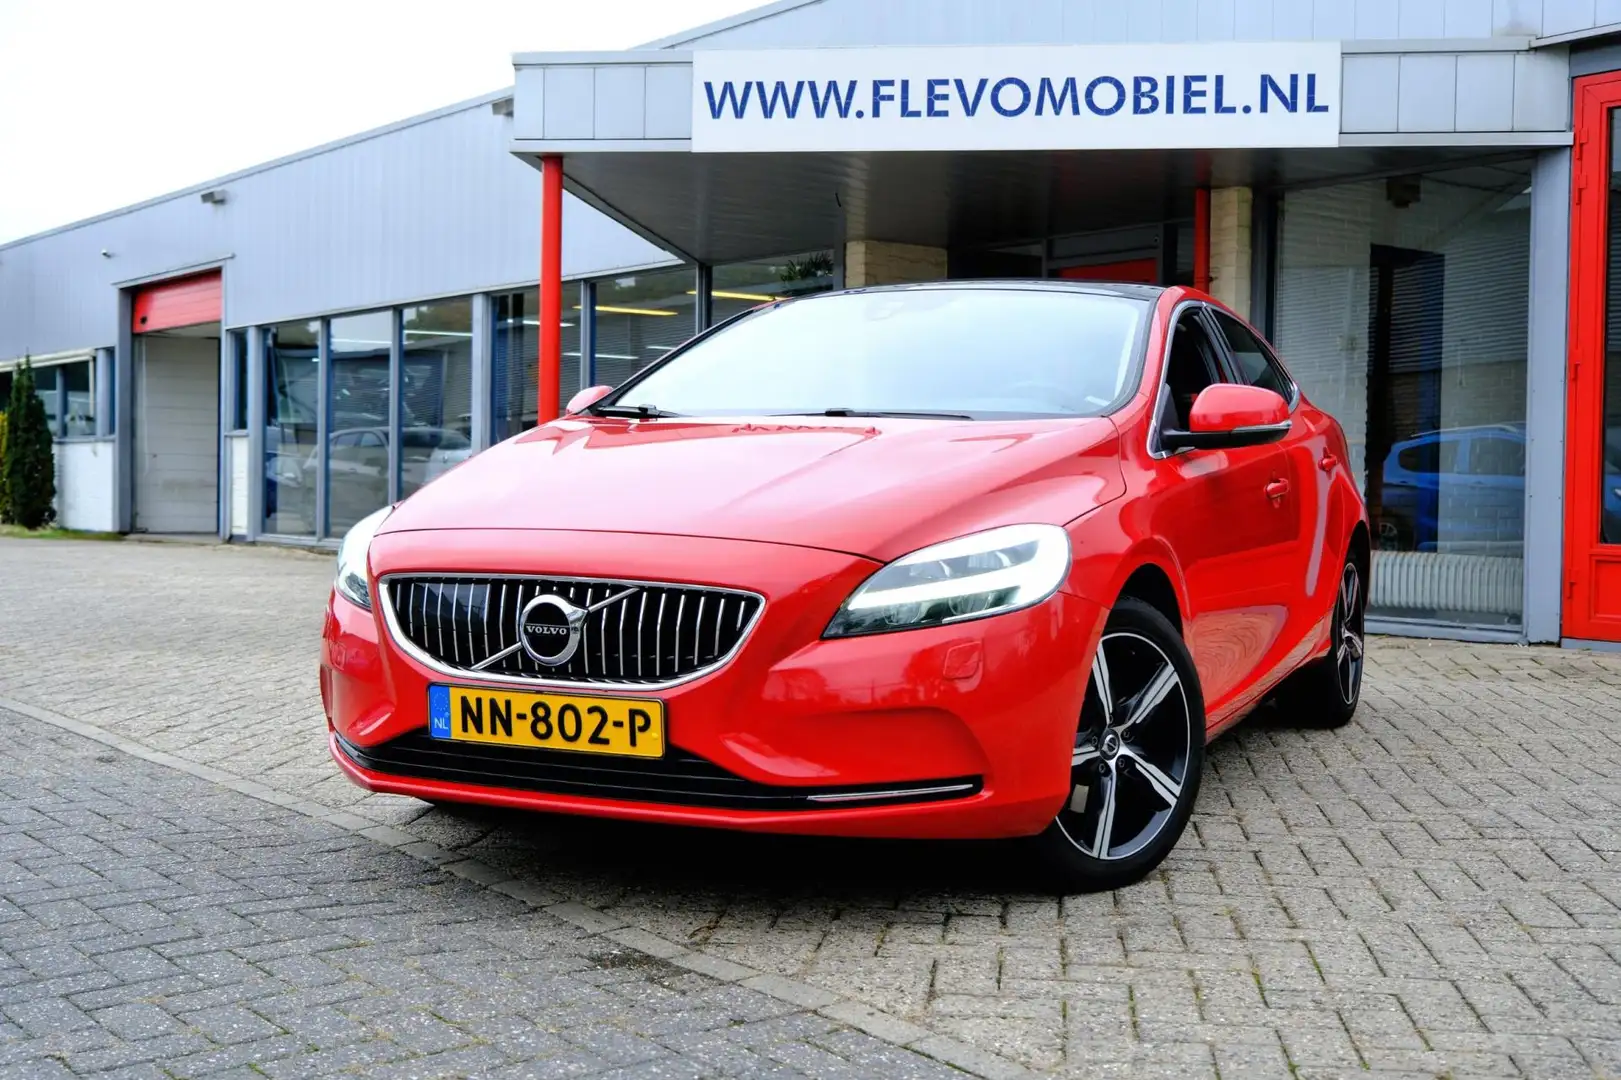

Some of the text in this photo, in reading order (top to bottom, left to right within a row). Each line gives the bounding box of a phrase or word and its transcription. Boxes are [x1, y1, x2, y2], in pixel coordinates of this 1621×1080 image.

[704, 73, 1329, 119] WWW.FLEVOMOBIEL.NL
[526, 625, 567, 635] VOLVO
[434, 717, 449, 730] NL
[460, 695, 651, 747] NN-802-P
